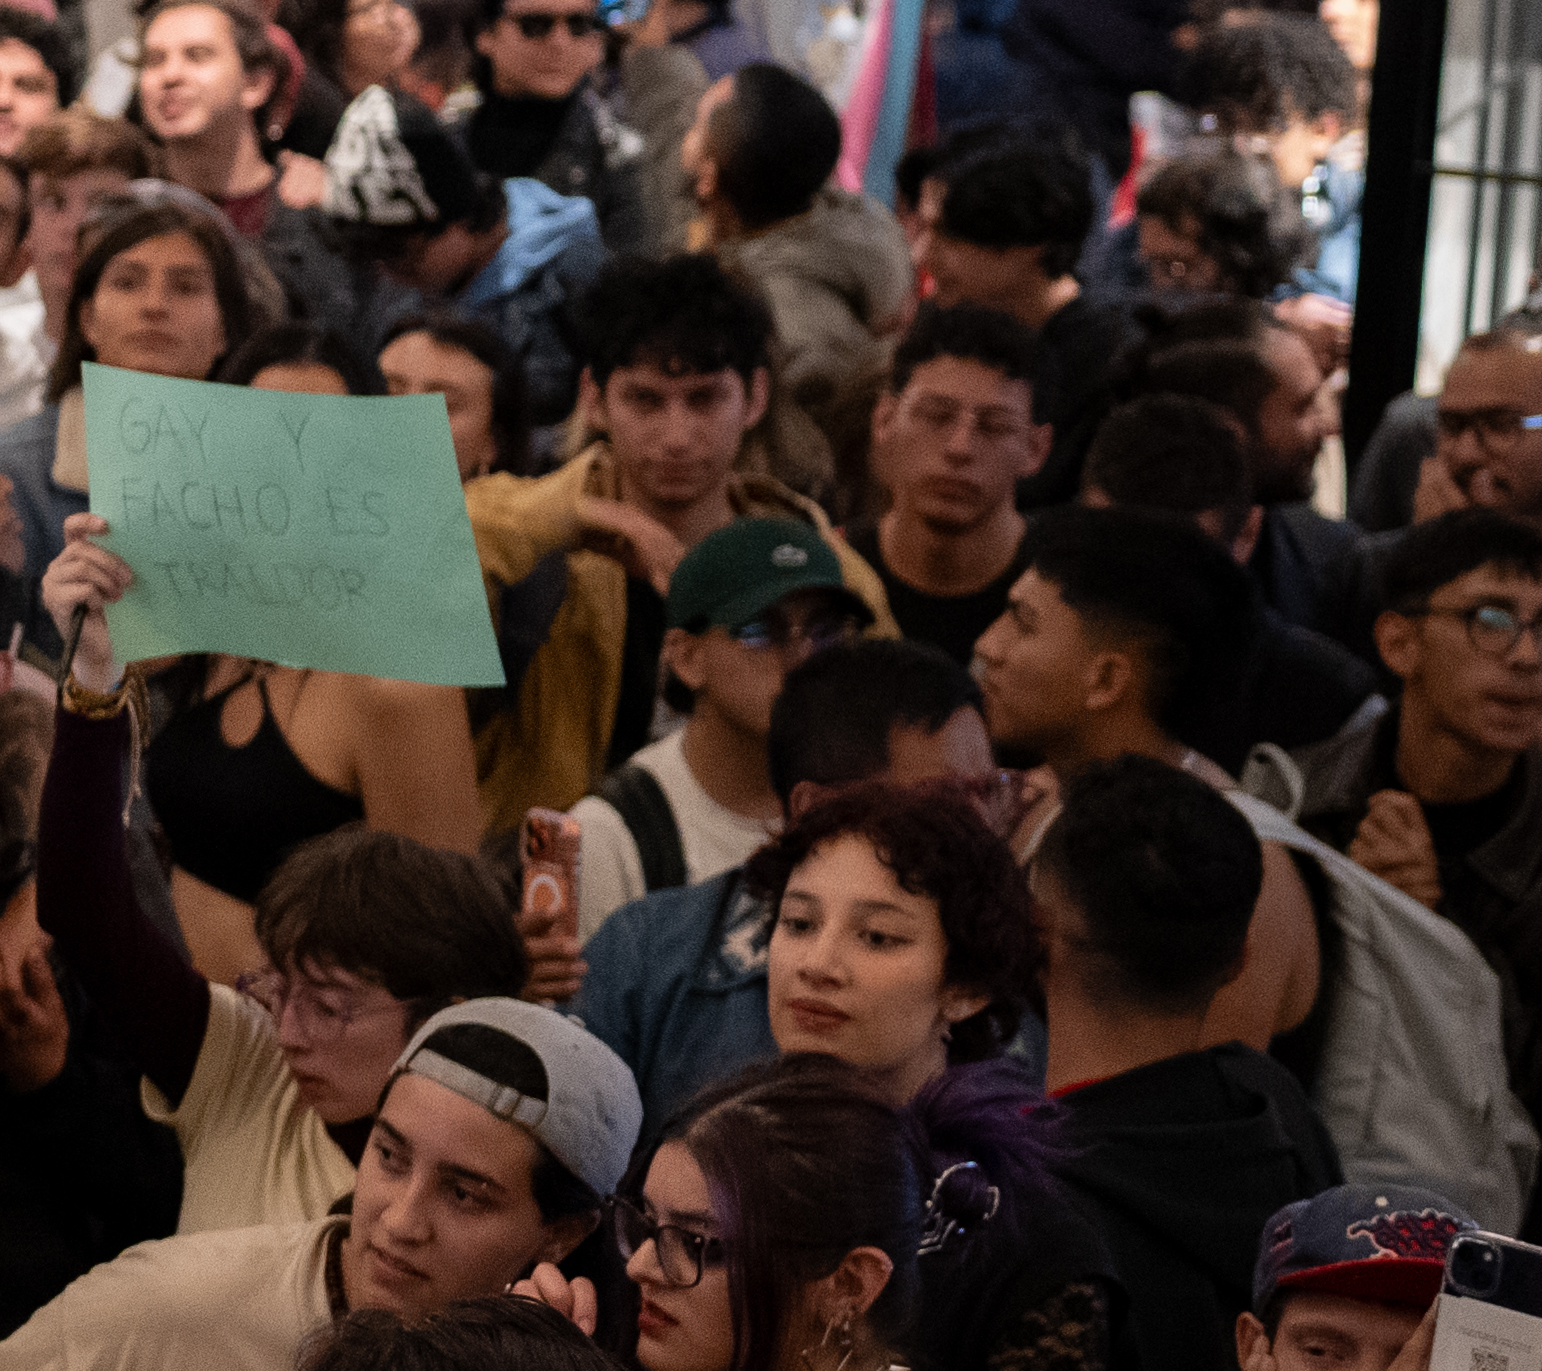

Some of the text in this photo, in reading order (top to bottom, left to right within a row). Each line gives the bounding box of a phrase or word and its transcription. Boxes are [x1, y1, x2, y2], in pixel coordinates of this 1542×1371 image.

[117, 395, 211, 467] GAY
[119, 475, 391, 538] FACHO ES
